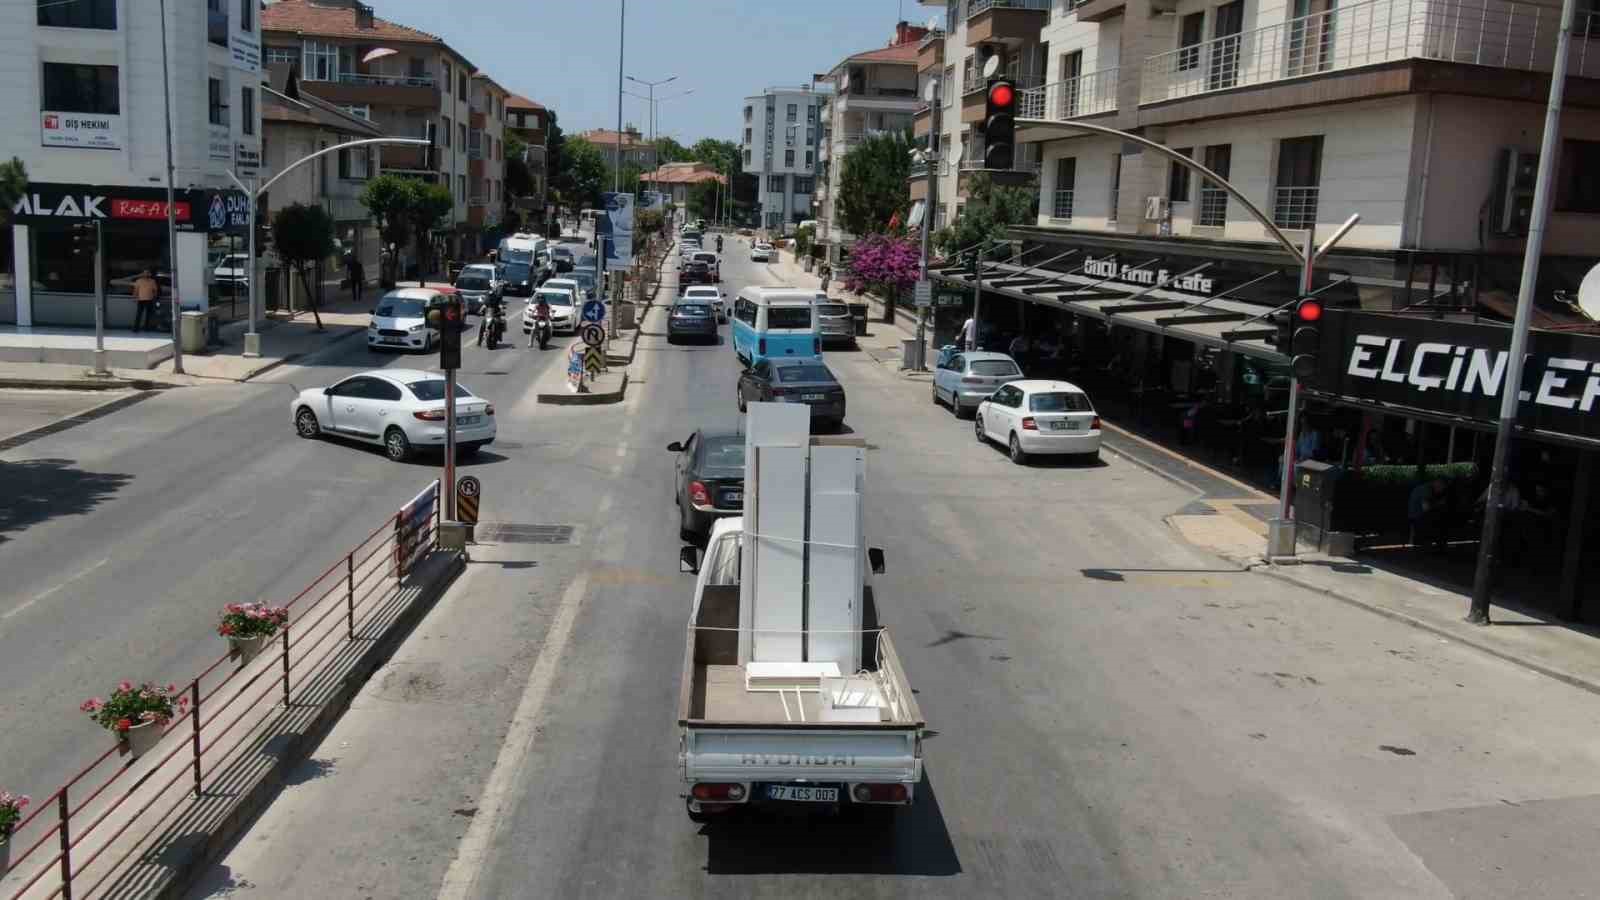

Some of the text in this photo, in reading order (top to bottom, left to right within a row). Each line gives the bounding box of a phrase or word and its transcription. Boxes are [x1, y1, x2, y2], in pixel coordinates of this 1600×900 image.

[1157, 269, 1169, 287] &
[1173, 273, 1213, 293] cafe
[770, 786, 836, 801] 77 ACS 003
